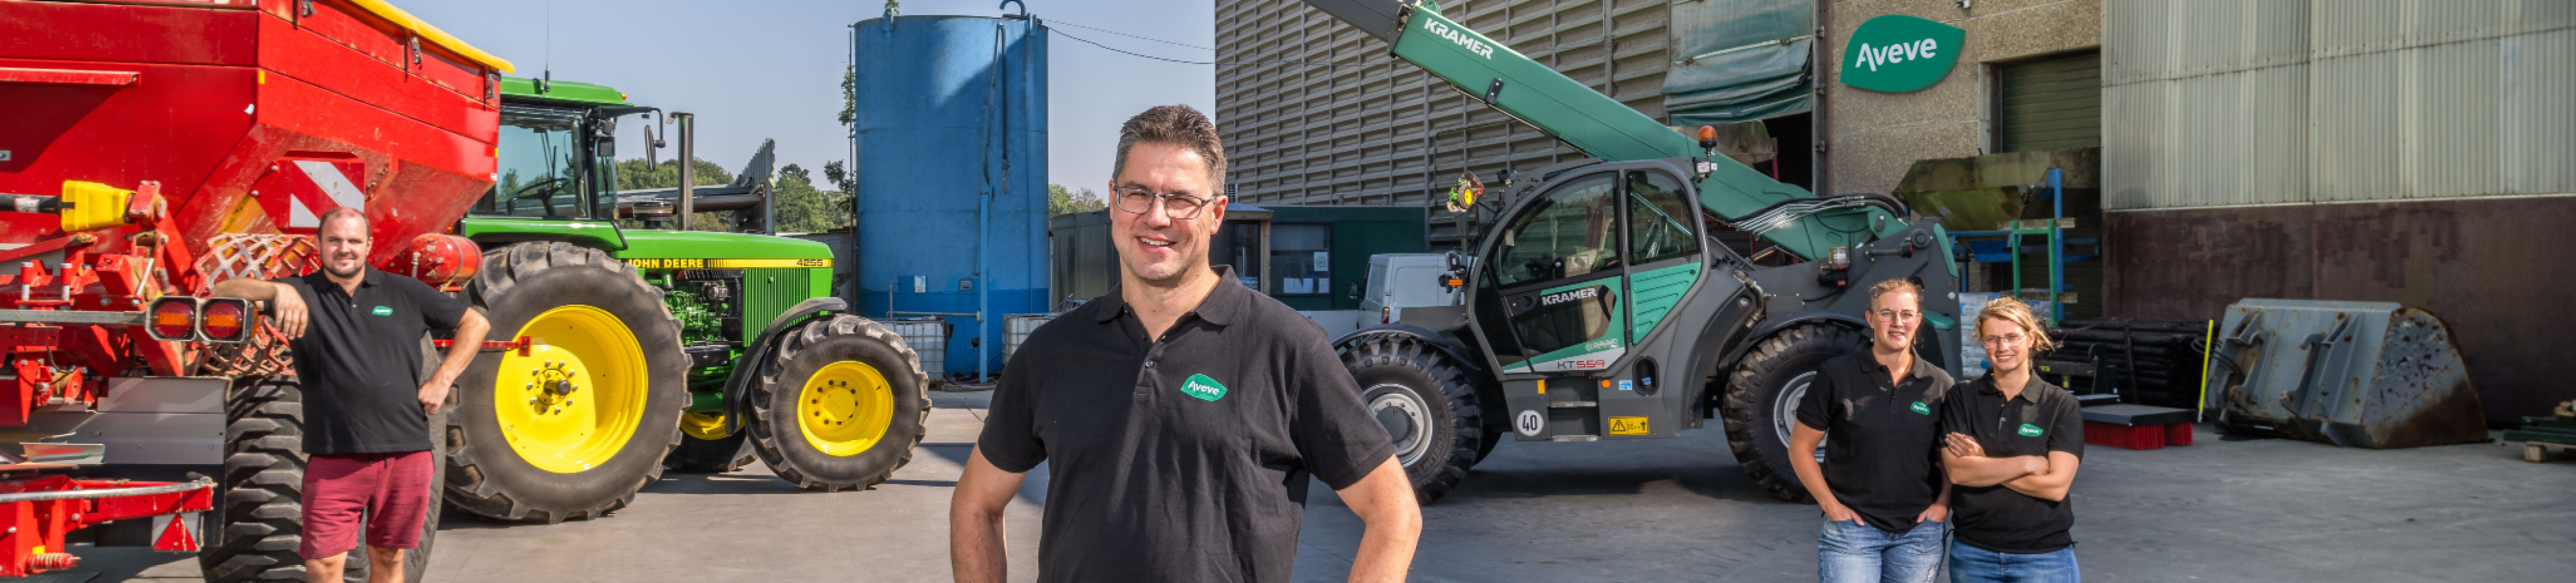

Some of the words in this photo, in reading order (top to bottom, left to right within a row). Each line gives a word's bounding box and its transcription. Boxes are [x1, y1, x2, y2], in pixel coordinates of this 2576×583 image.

[1423, 17, 1493, 59] KRAMER
[1855, 38, 1937, 71] Aveve
[664, 259, 703, 267] DEERE
[1542, 288, 1597, 305] KRAMER
[1188, 380, 1219, 395] Aveve
[1522, 415, 1537, 430] 40
